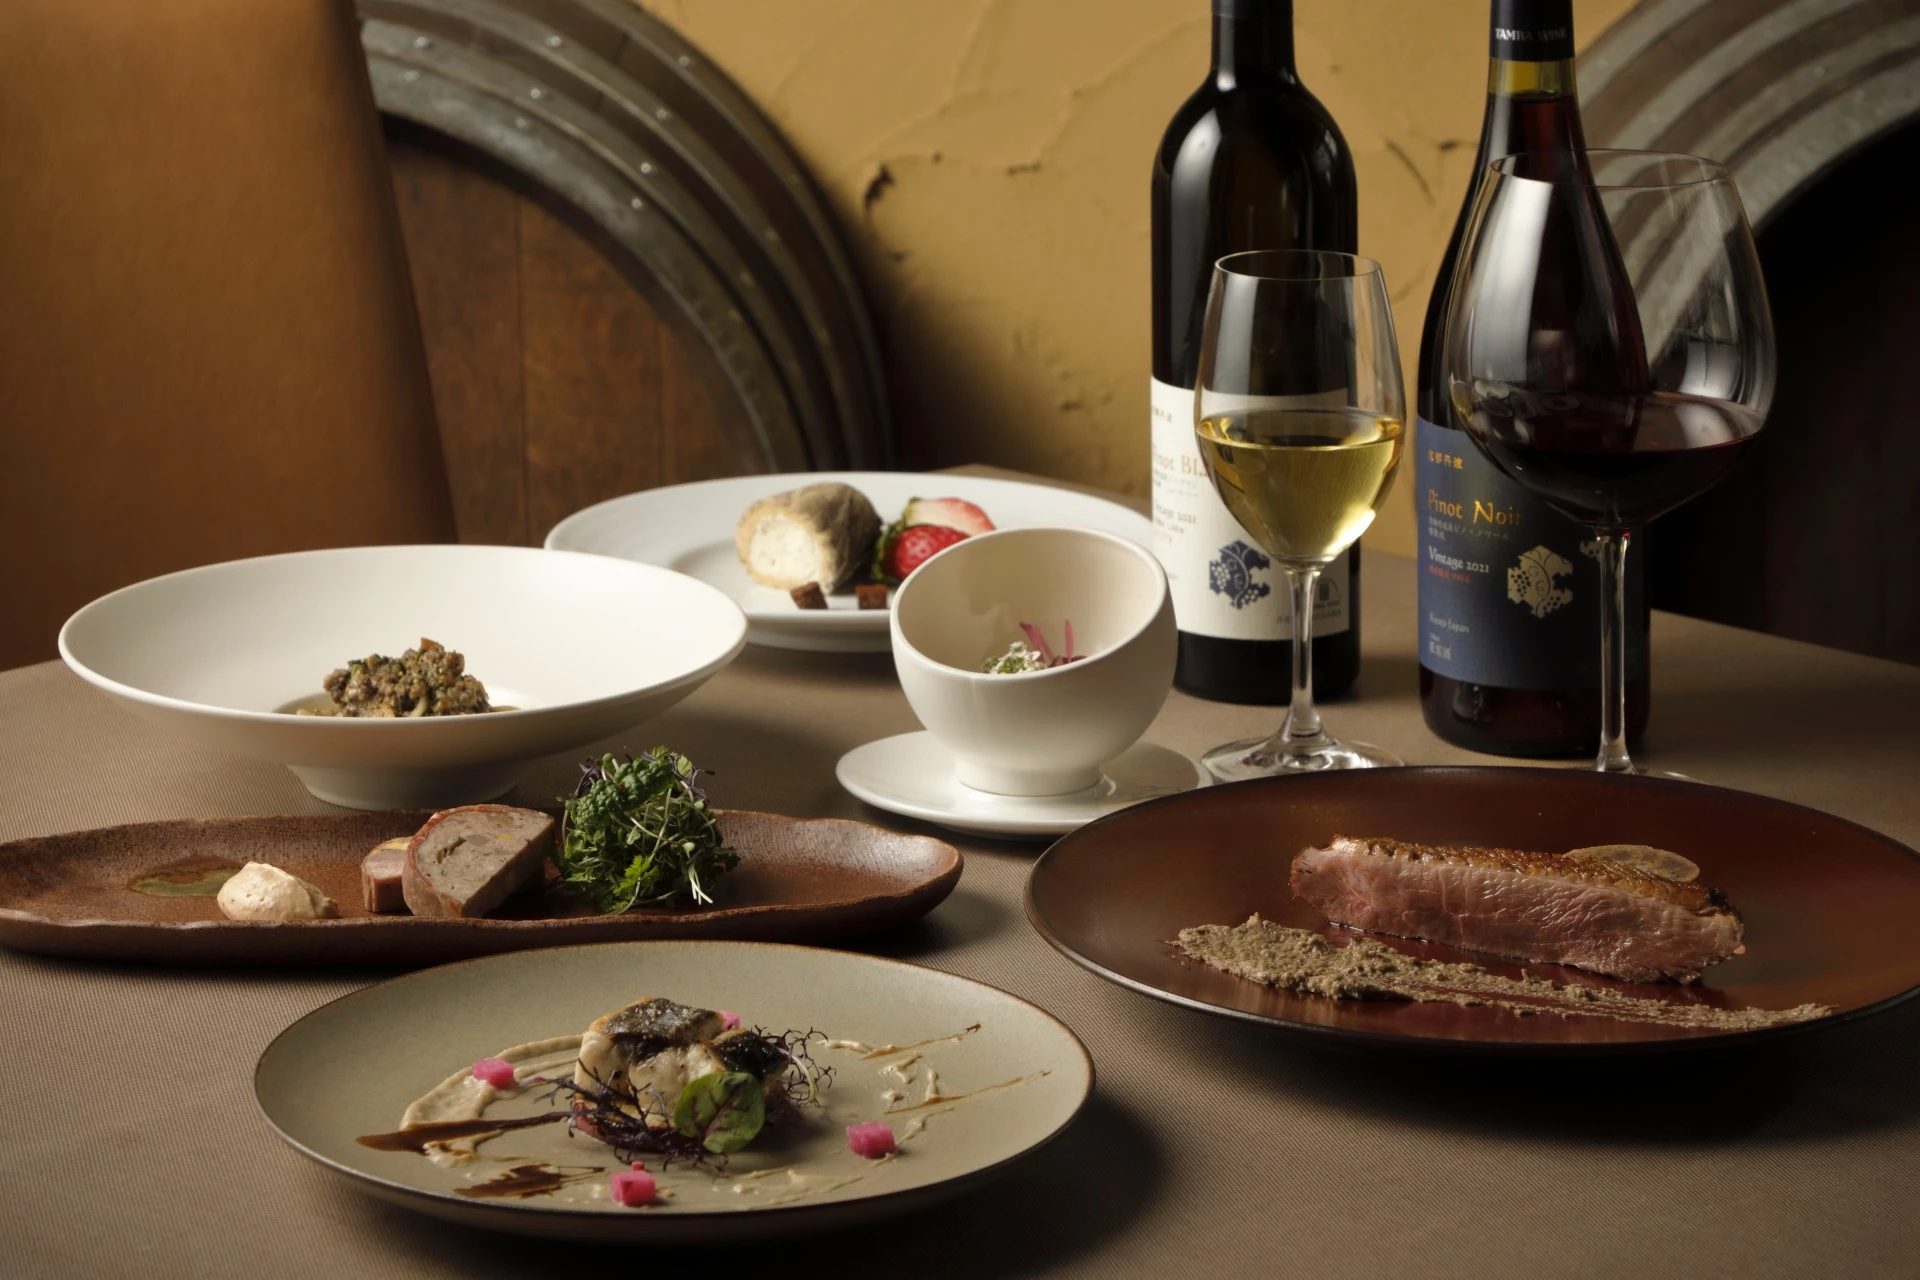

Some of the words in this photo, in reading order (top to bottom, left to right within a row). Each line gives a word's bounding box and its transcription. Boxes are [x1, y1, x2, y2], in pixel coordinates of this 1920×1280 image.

[1494, 27, 1534, 41] TAMBA
[1536, 26, 1569, 42] WINE
[1428, 488, 1464, 519] Pinot
[1428, 544, 1464, 570] Vintage
[1465, 560, 1490, 574] 2021
